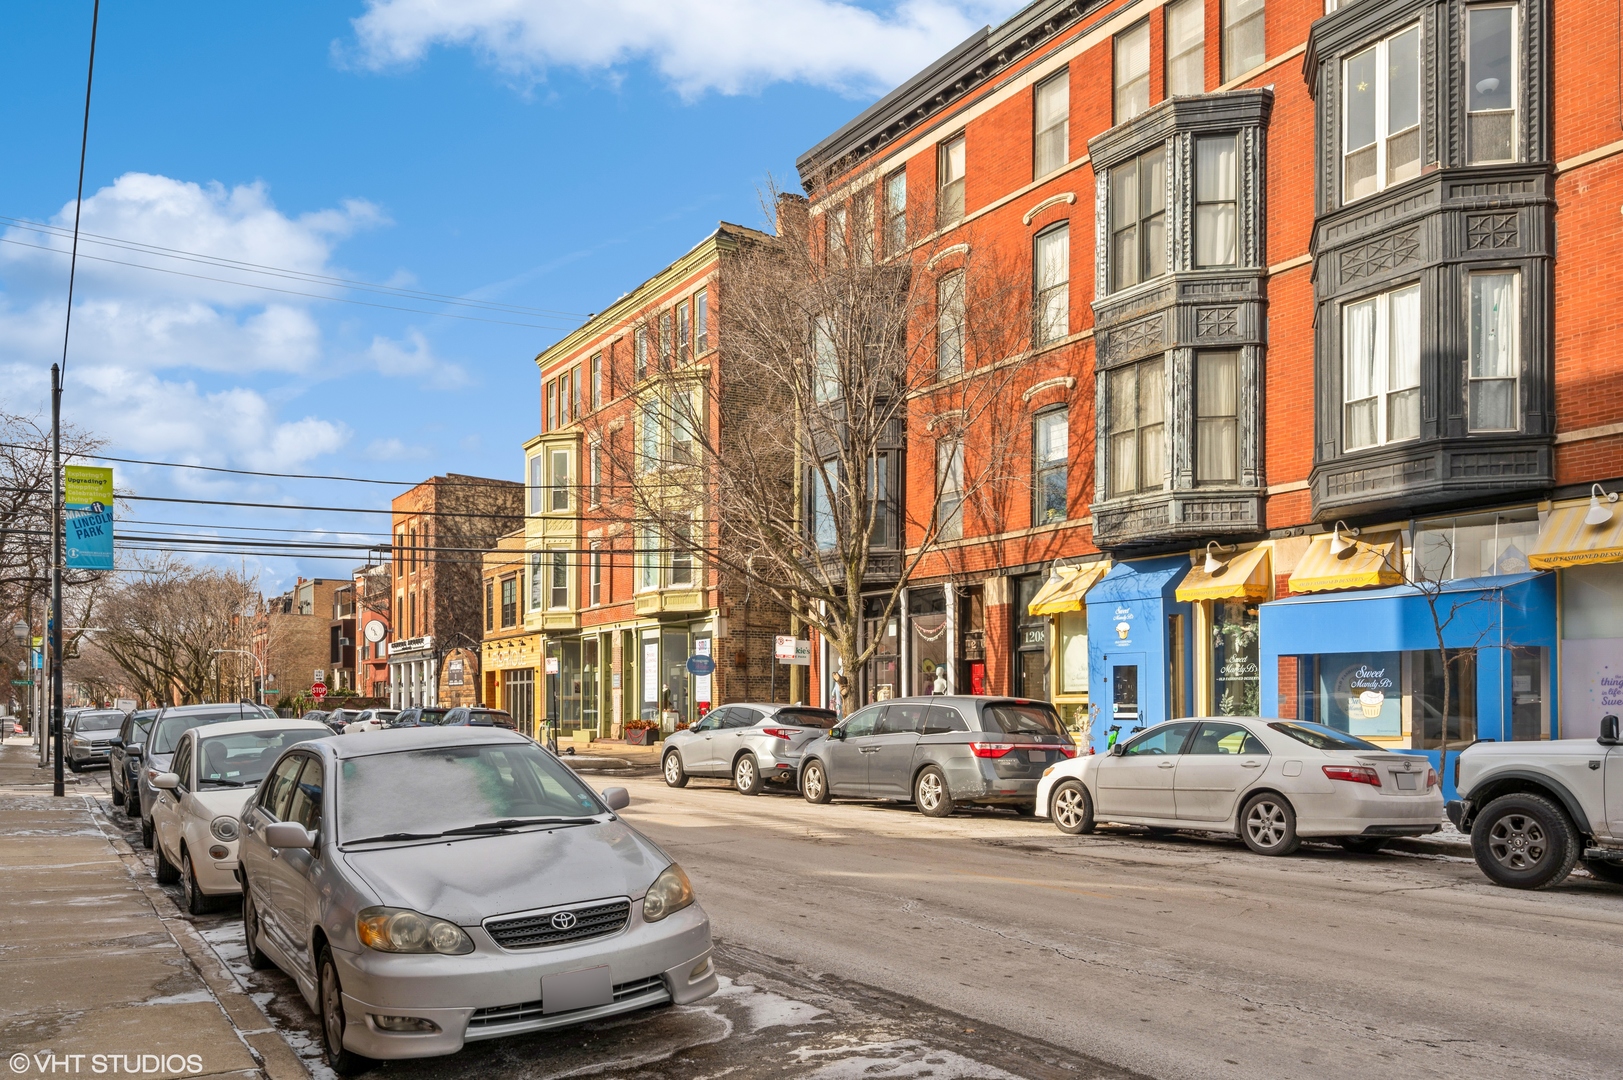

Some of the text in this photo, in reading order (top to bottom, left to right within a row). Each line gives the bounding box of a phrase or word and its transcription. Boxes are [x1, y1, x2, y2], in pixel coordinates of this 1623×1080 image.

[68, 477, 107, 485] Upgrading?
[66, 502, 103, 520] MAKE it
[73, 512, 114, 529] LINCOLN
[76, 525, 104, 540] PARK
[1559, 553, 1599, 562] FASHIONED
[1115, 605, 1131, 615] Sweet
[1025, 630, 1045, 643] 1208
[1230, 653, 1248, 663] Sweet
[1220, 663, 1246, 676] Mandy
[1355, 665, 1385, 679] Sweet
[312, 686, 326, 694] STOP
[1351, 677, 1393, 690] Mandy B's
